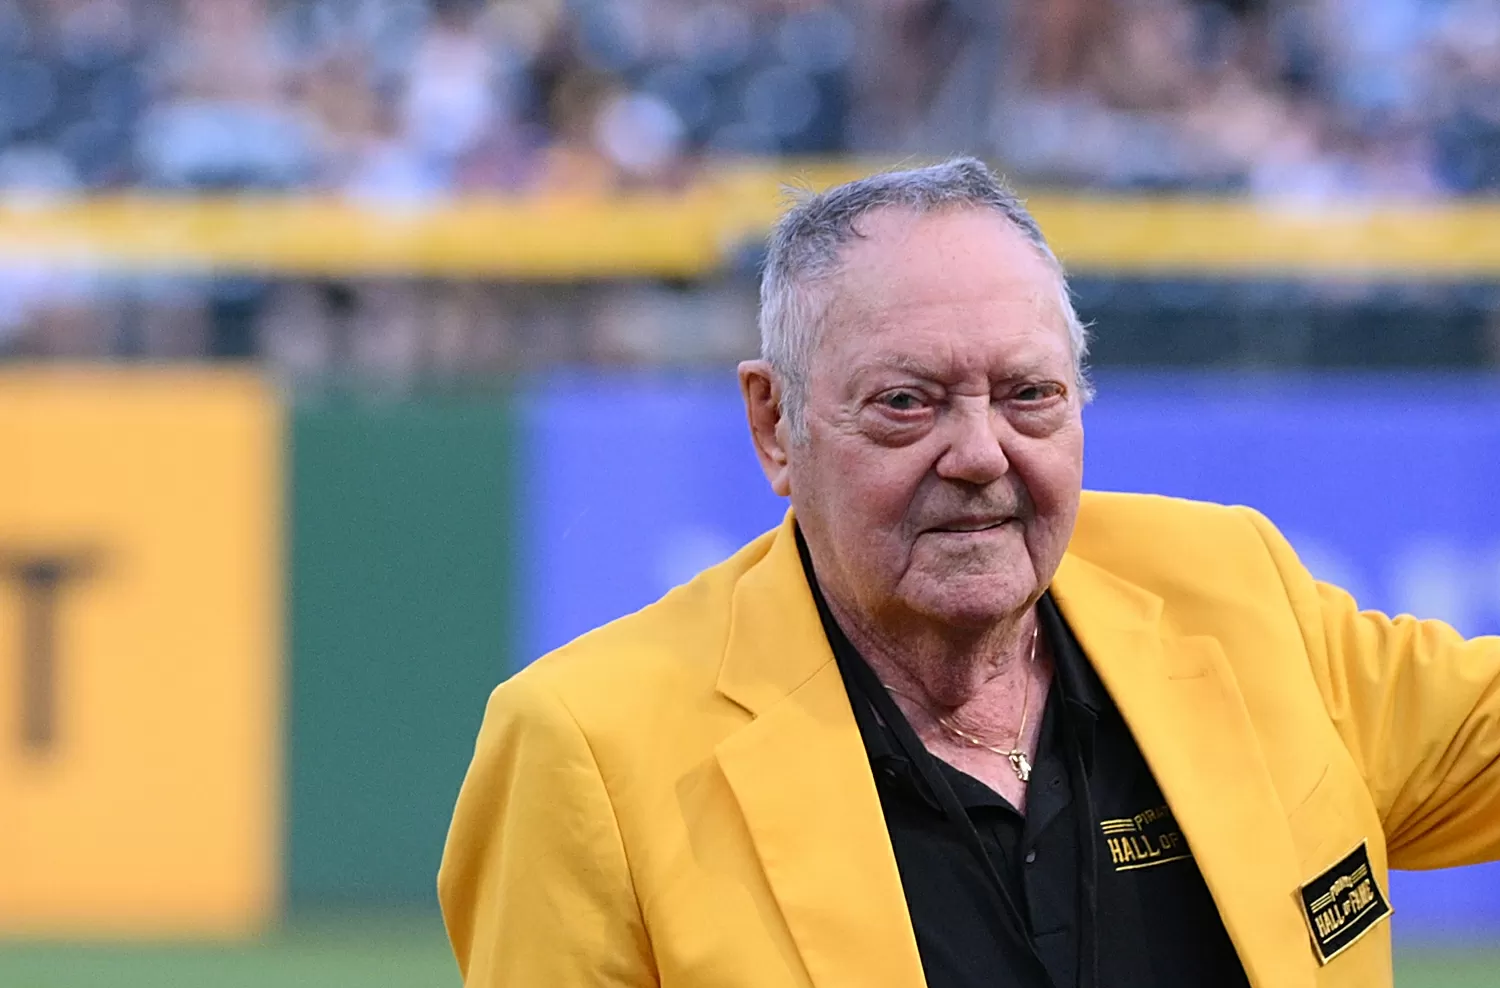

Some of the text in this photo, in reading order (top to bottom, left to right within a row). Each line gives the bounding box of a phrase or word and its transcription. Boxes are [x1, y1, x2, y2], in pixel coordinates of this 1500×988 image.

[1107, 835, 1161, 864] HALL
[1314, 904, 1345, 938] HALL
[1348, 878, 1374, 914] FAME
